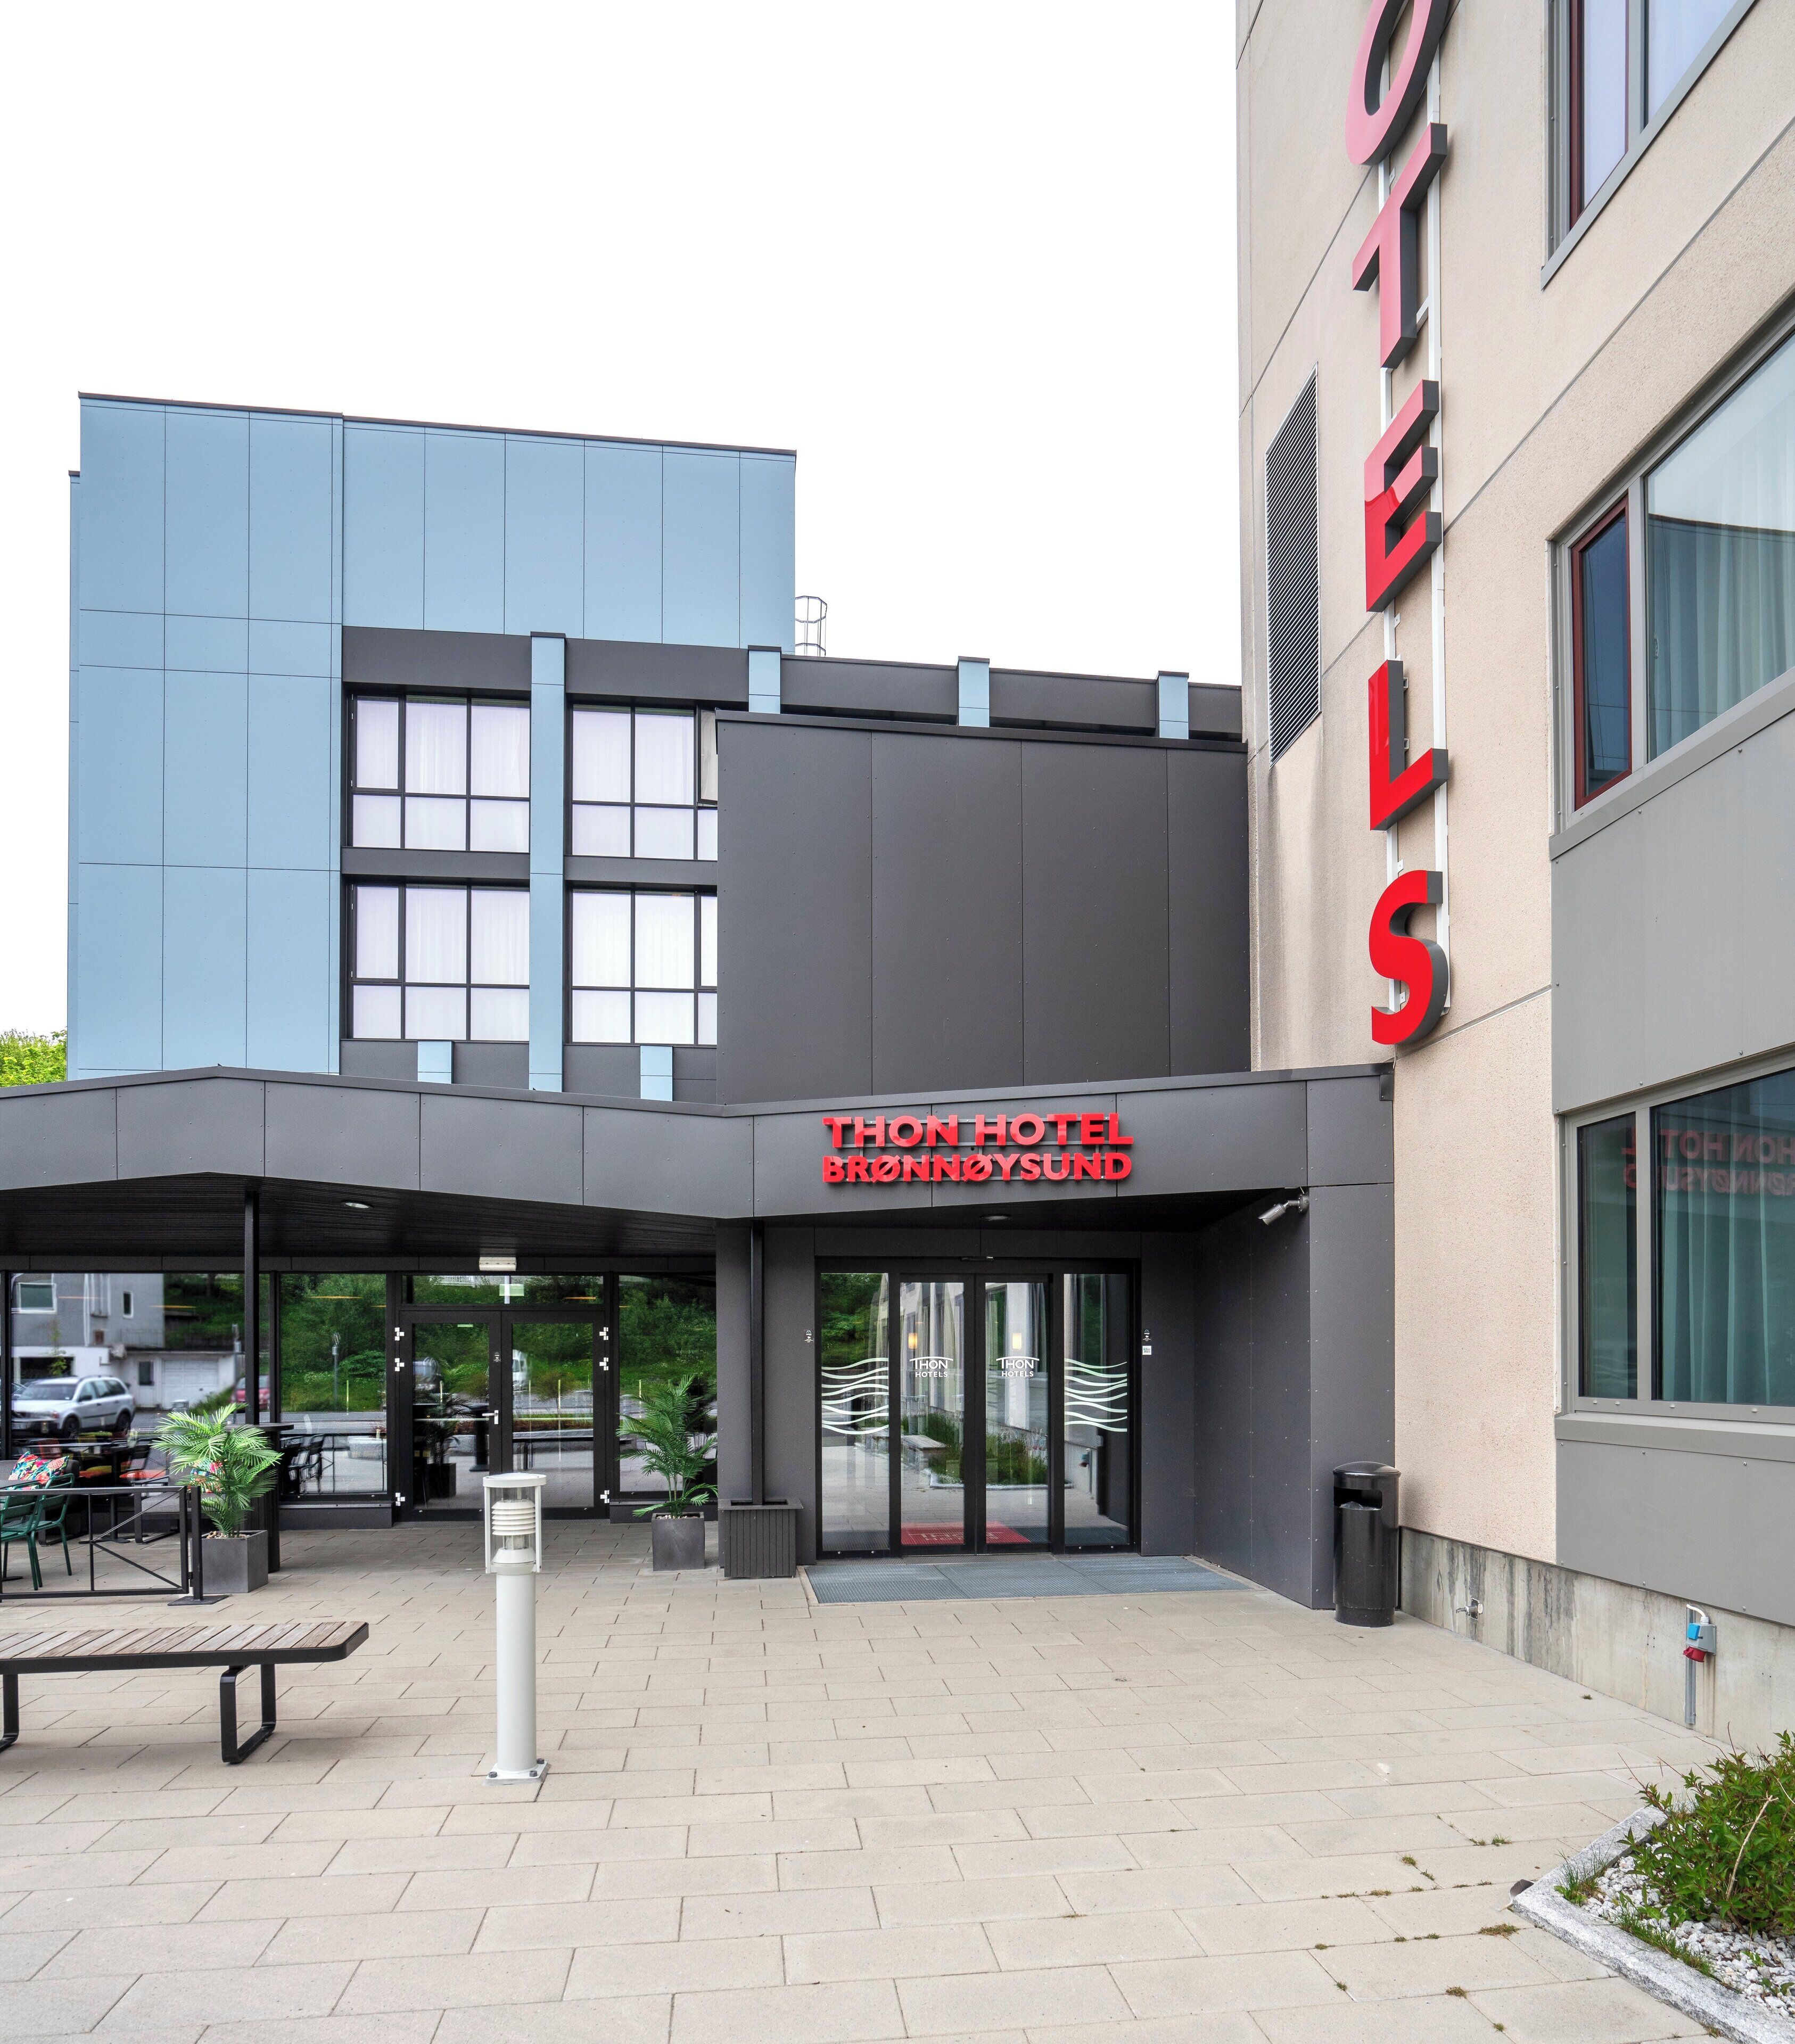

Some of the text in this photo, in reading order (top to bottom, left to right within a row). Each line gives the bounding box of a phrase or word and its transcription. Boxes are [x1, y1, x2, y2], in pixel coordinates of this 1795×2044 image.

[822, 1113, 1133, 1148] THON HOTEL
[823, 1152, 1132, 1183] BRØNNØYSUND
[909, 1356, 953, 1370] THON
[996, 1356, 1040, 1369] THON
